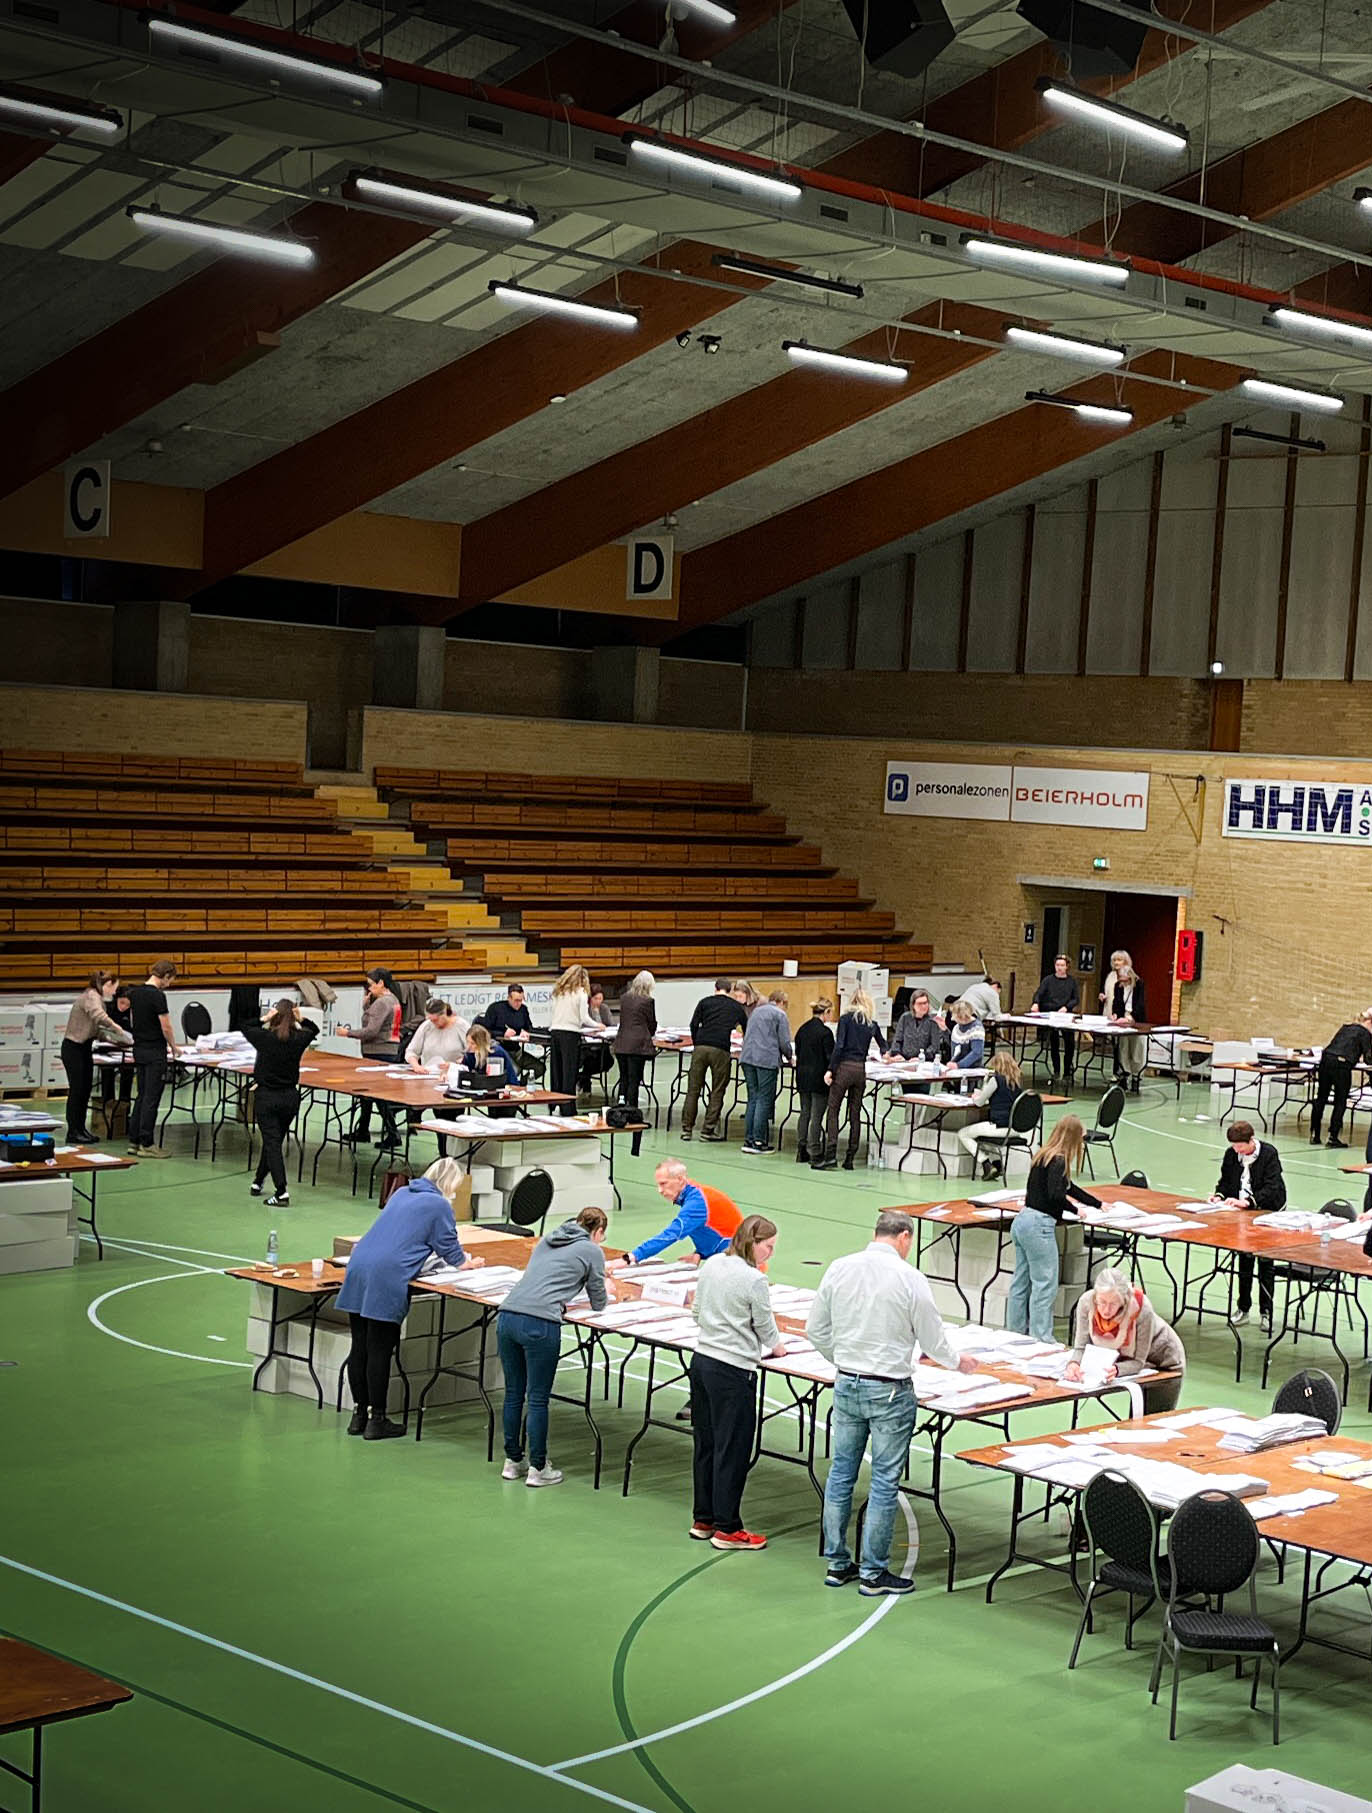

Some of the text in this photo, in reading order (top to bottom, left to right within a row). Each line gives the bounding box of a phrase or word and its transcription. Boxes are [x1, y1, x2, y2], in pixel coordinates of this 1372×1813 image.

[70, 467, 102, 531] C
[634, 543, 664, 593] D
[916, 781, 1009, 798] personalezonen
[1015, 788, 1143, 808] BEIERHOLM
[1228, 784, 1354, 834] HHM
[455, 993, 491, 1005] LEDIGT
